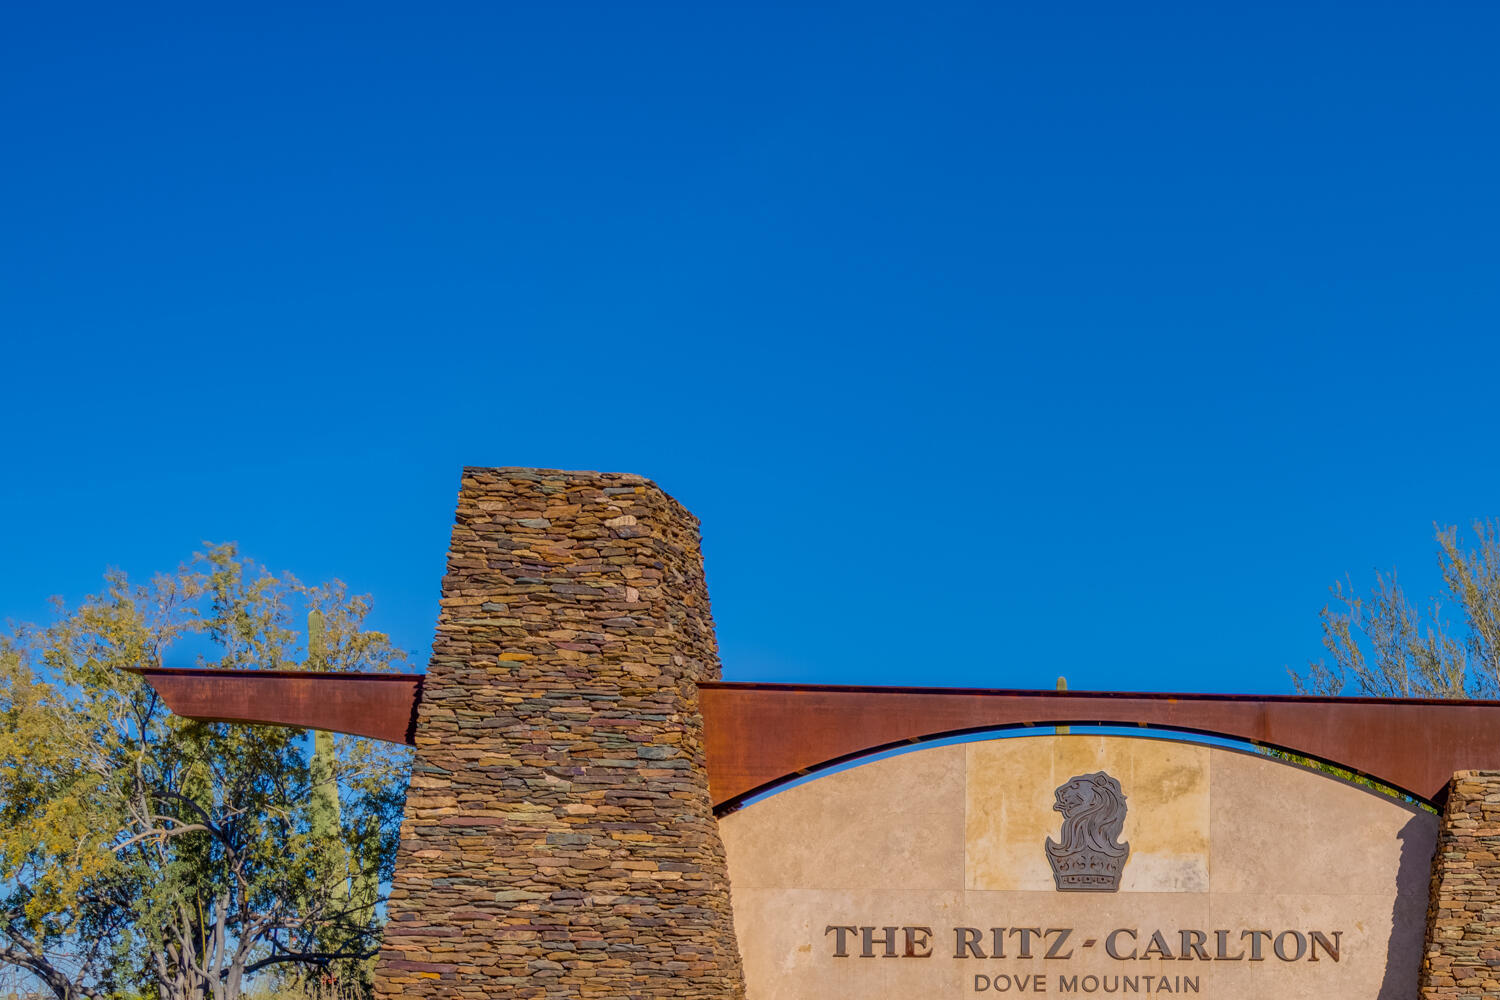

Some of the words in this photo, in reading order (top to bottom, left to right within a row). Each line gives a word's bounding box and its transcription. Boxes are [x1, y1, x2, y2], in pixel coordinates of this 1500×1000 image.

[825, 925, 934, 959] THE
[974, 974, 1047, 993] DOVE
[1059, 974, 1201, 994] MOUNTAIN
